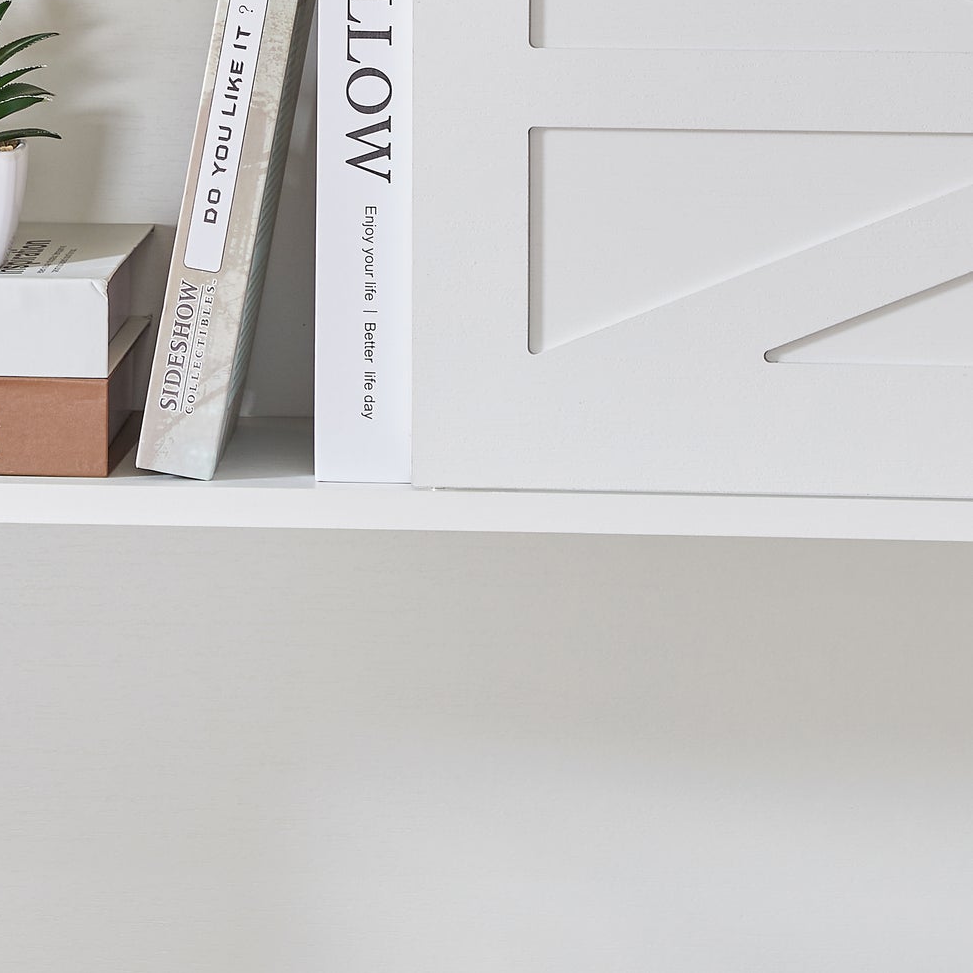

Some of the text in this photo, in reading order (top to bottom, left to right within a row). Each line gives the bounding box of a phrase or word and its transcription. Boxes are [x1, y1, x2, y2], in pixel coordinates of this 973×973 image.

[233, 25, 251, 50] IT
[221, 58, 244, 116] LIKE
[212, 125, 232, 176] YOU
[203, 187, 221, 224] DO
[362, 205, 377, 244] Enjoy
[361, 247, 374, 278] your
[364, 281, 377, 301] life
[159, 279, 198, 412] SIDESHOW
[364, 322, 376, 363] Better
[364, 371, 376, 390] life
[361, 394, 376, 420] day
